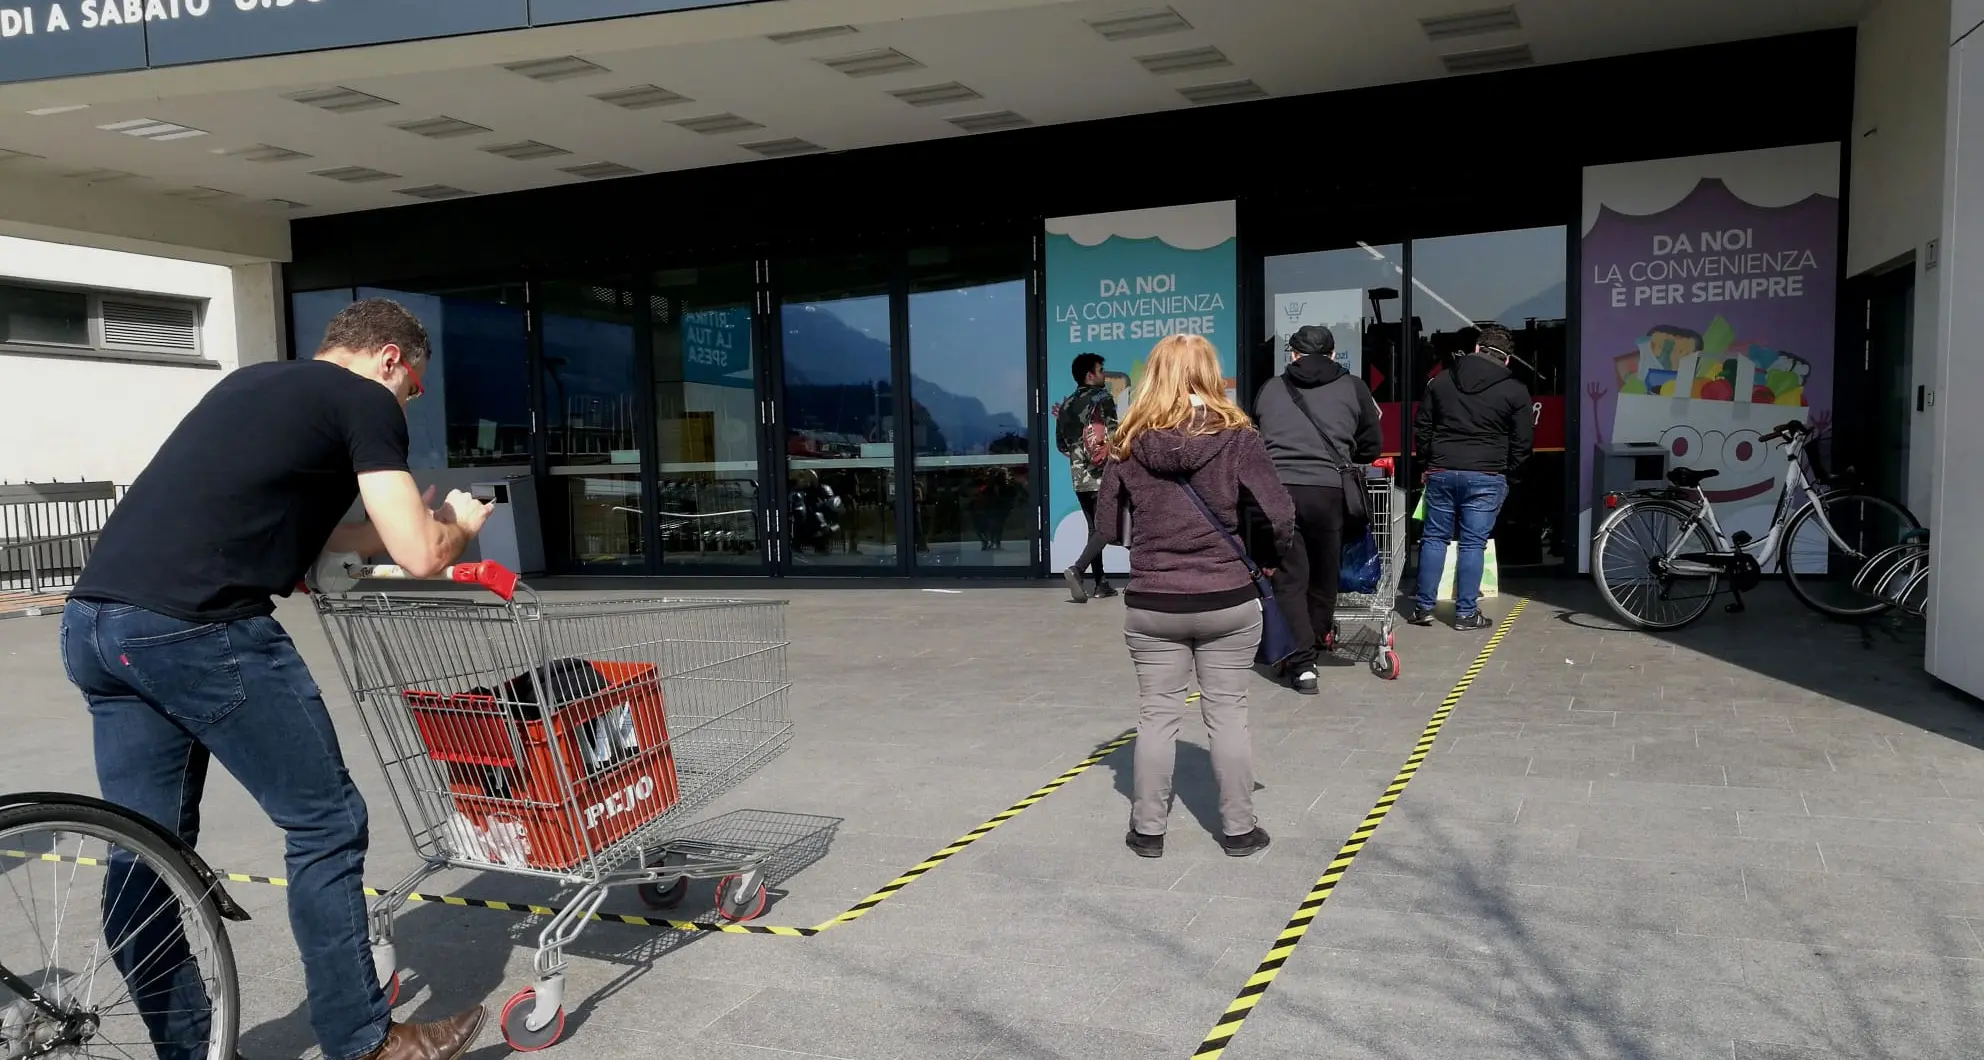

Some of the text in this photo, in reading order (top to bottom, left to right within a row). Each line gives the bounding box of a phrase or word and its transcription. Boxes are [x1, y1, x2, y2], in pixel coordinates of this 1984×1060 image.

[47, 3, 70, 32] A
[81, 0, 209, 28] SABATO
[1653, 228, 1753, 256] DA NOI
[1594, 249, 1817, 284] LA CONVENIENZA
[1100, 274, 1176, 298] DA NOI
[1611, 276, 1804, 308] È PER SEMPRE
[1056, 293, 1225, 323] LA CONVENIENZA
[1069, 315, 1215, 344] È PER SEMPRE
[584, 776, 653, 830] PEJO
